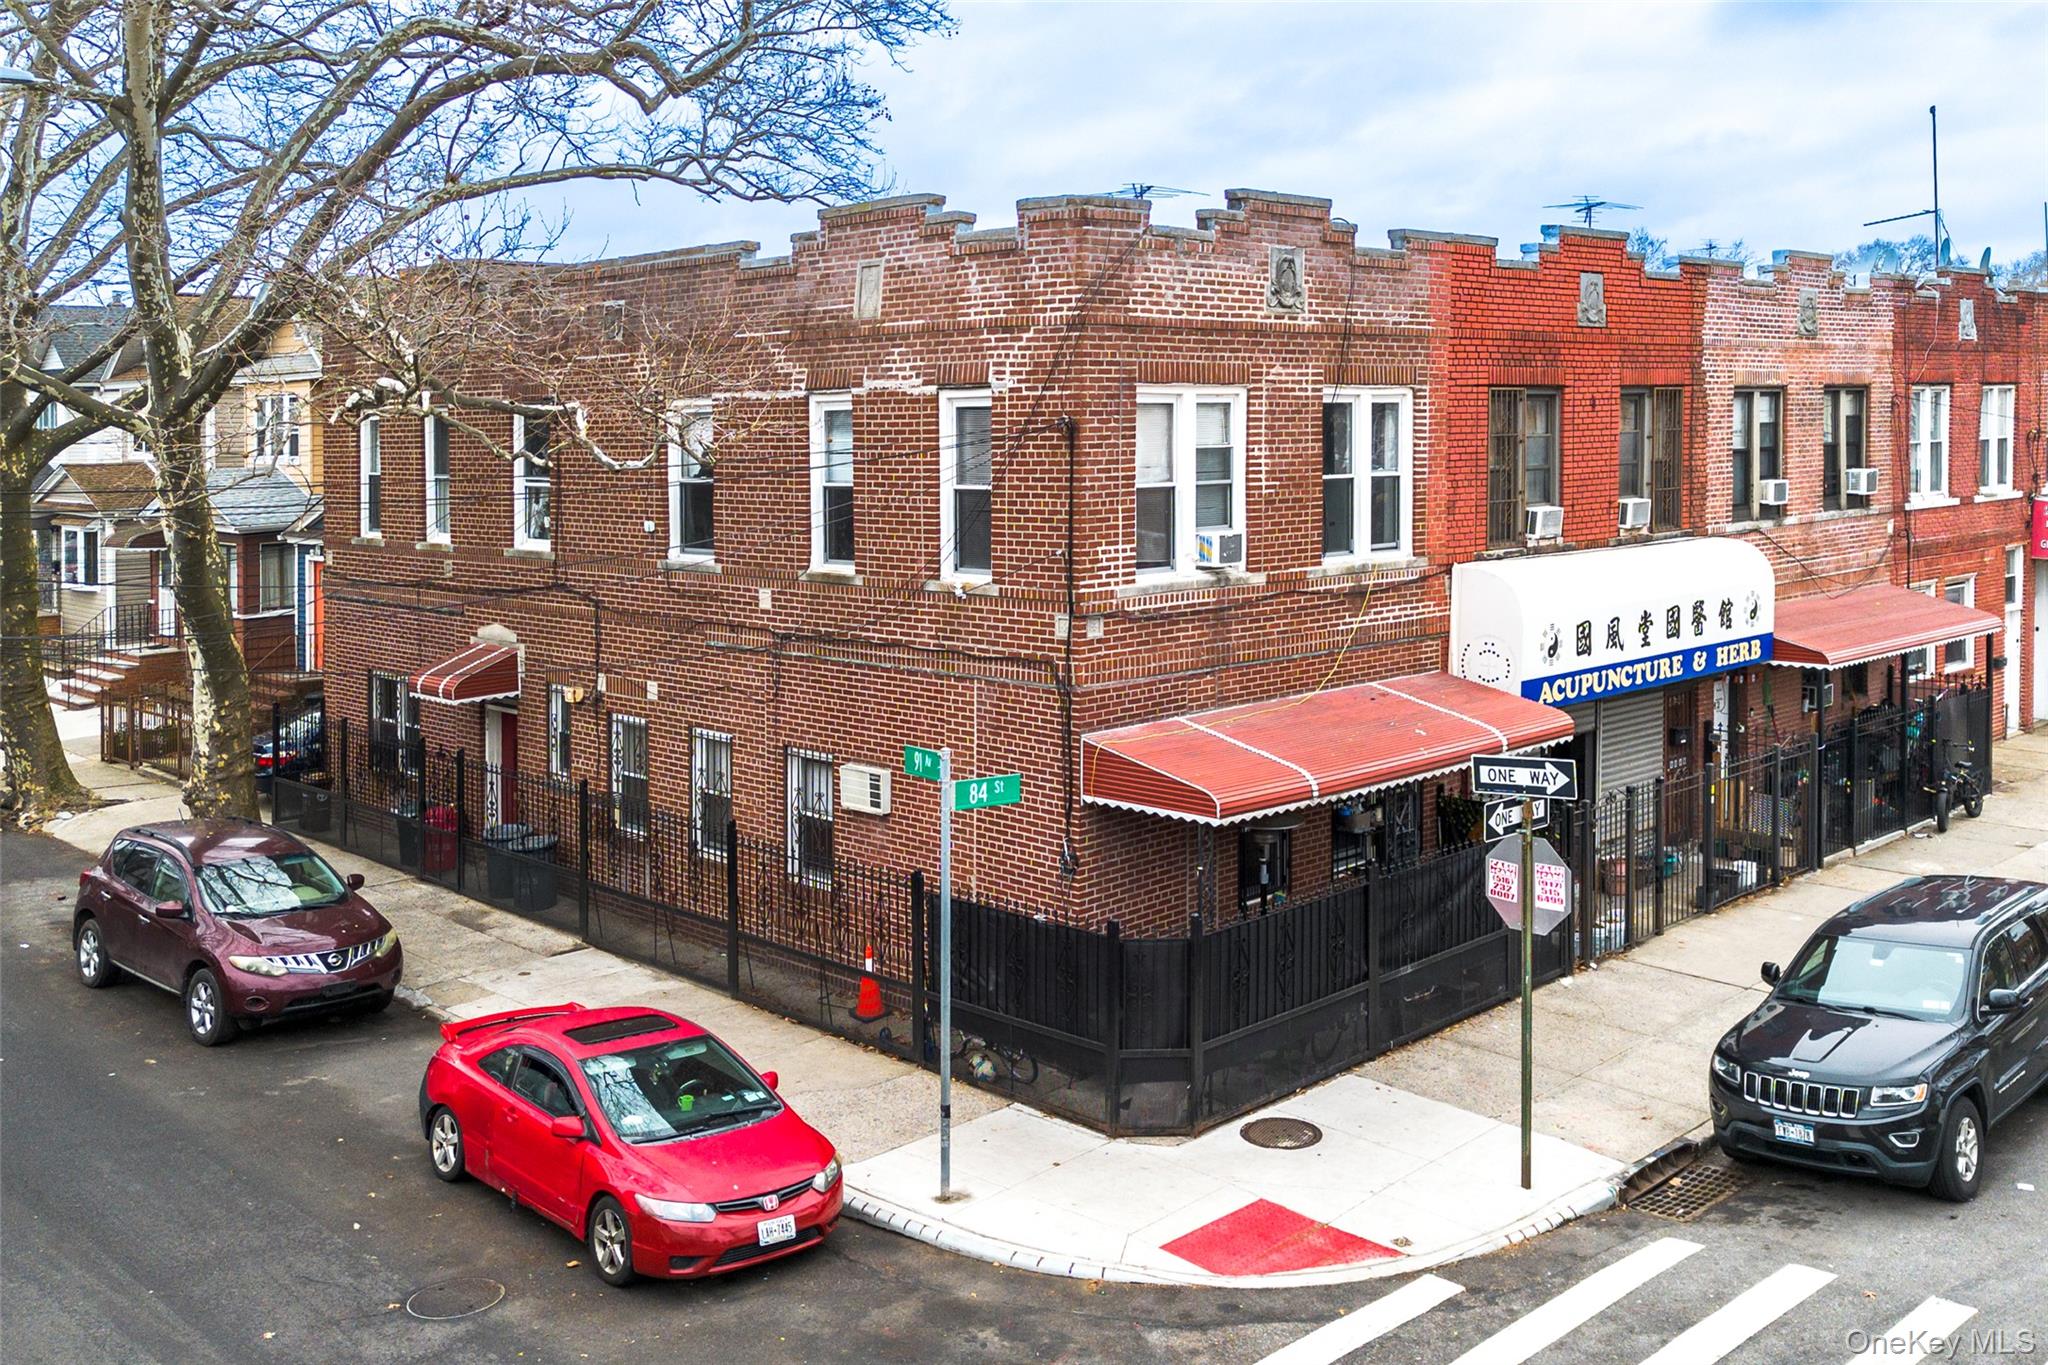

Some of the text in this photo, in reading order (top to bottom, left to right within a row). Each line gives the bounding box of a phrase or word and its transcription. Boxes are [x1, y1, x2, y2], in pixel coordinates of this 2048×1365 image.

[1538, 638, 1761, 704] ACUPUNCTURE & HERB
[914, 751, 922, 772] 91
[1488, 768, 1559, 786] ONE WAY
[969, 780, 1004, 804] 84 St
[1495, 809, 1513, 827] ONE
